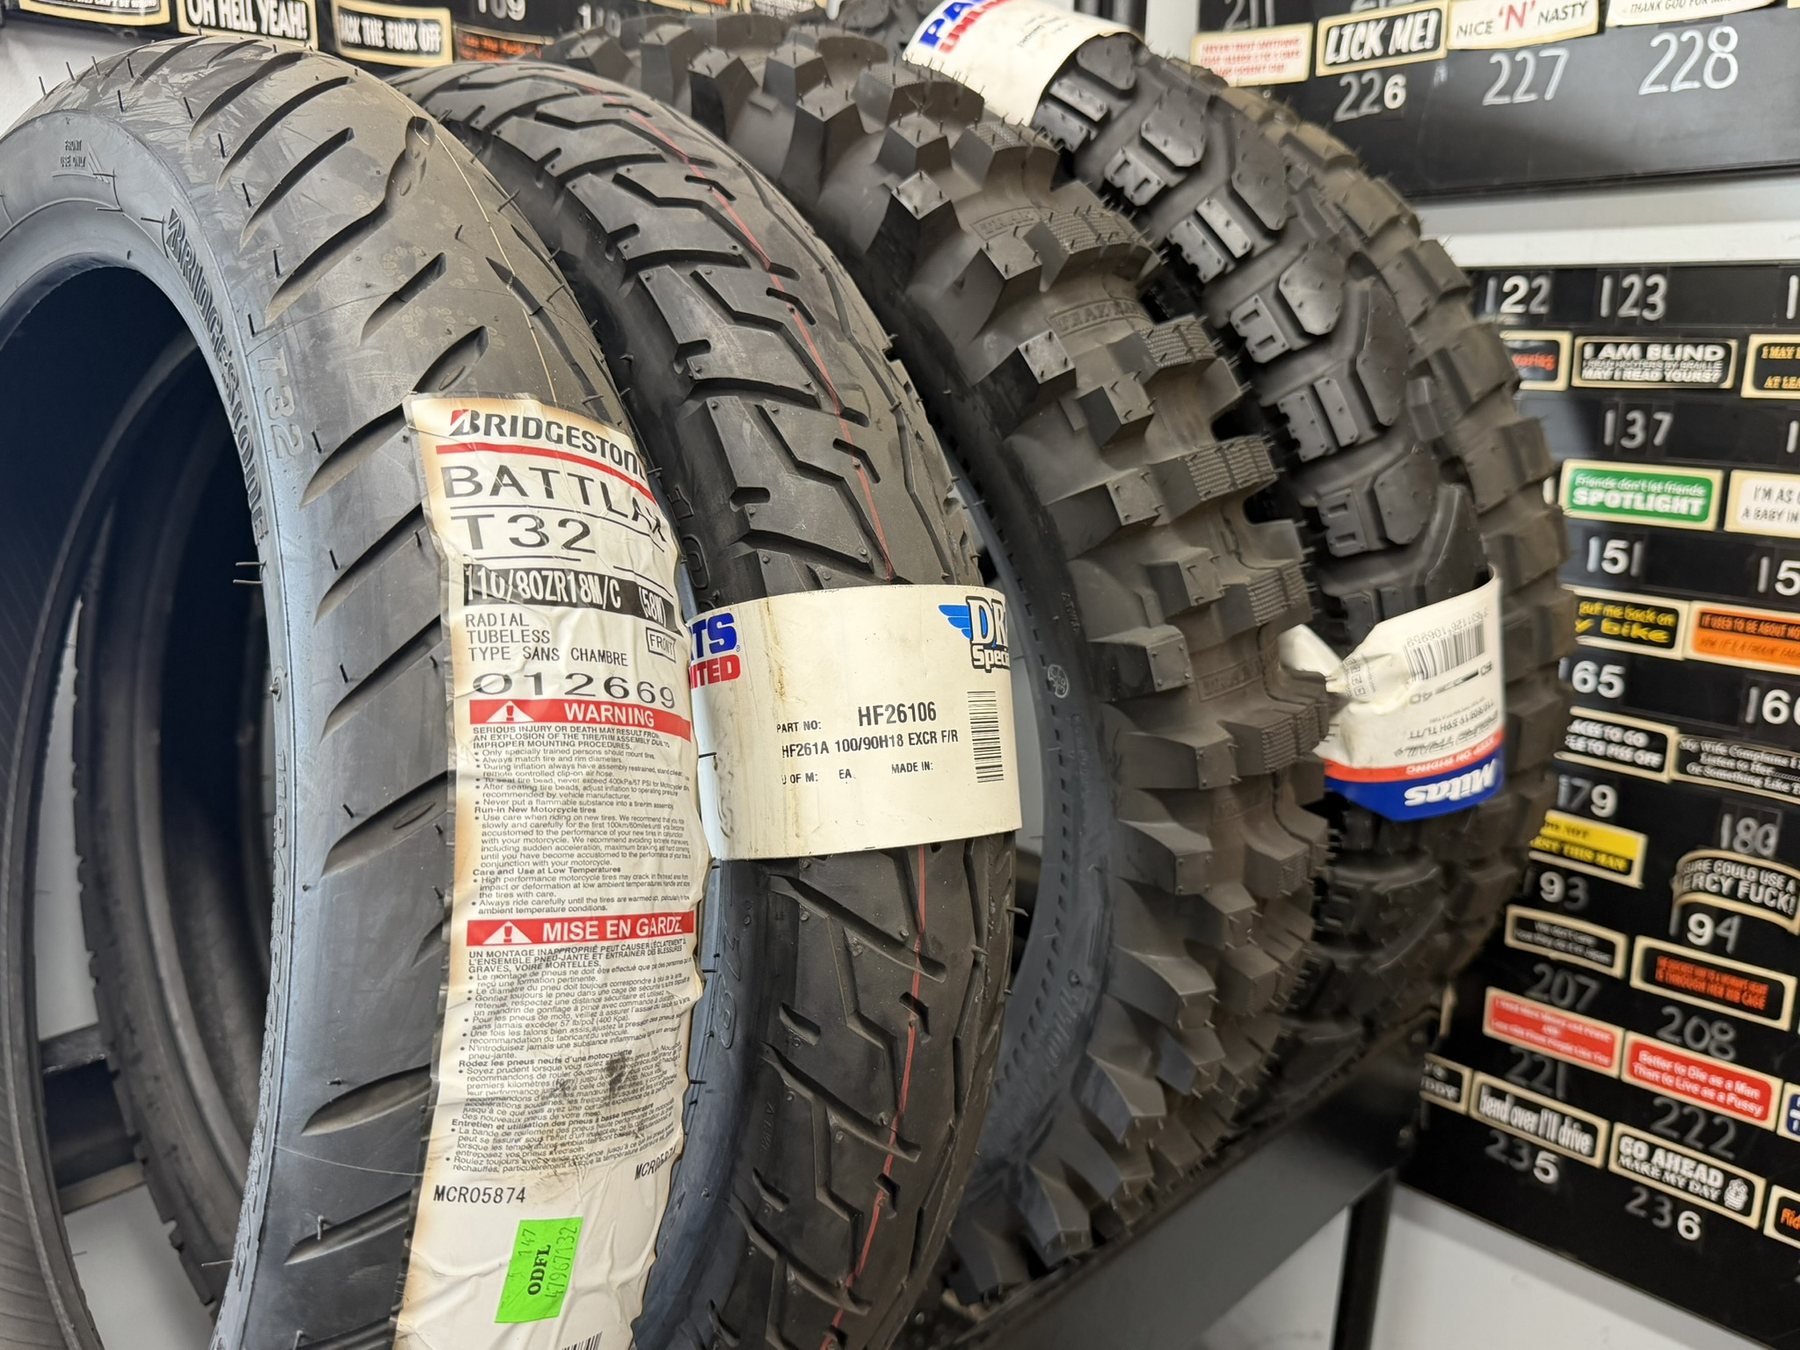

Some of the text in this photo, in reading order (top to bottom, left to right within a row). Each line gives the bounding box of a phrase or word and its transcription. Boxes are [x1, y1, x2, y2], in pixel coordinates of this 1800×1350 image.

[189, 0, 308, 39] OH HELL YEAH!
[385, 21, 418, 51] FUCK
[418, 22, 442, 53] OFF
[1324, 19, 1388, 66] LICK
[1388, 10, 1441, 56] ME!
[1456, 21, 1494, 39] NICE
[1537, 1, 1590, 25] NASTY
[1483, 48, 1569, 106] 227
[1638, 26, 1739, 95] 228
[1333, 73, 1407, 122] 226
[1485, 275, 1551, 315] 122
[1600, 274, 1668, 320] 123
[1583, 343, 1726, 362] I AM BLIND
[1623, 371, 1661, 382] READ
[1664, 372, 1723, 384] YOURS?
[1603, 410, 1674, 449] 137
[440, 464, 667, 542] BATTLAX
[1572, 487, 1707, 517] SPOTLIGHT
[450, 513, 596, 554] T32
[1586, 535, 1643, 577] 151
[465, 564, 622, 610] 110/80ZR18M/C
[1757, 556, 1800, 597] 15
[465, 613, 529, 627] RADIAL
[467, 629, 550, 644] TUBELESS
[1601, 618, 1670, 643] bike
[468, 646, 628, 666] TYPE SANS CHAMBRE
[649, 634, 674, 655] FRONT
[472, 672, 675, 709] 012669
[1558, 656, 1626, 699] 165
[563, 703, 655, 727] WARNING
[776, 701, 937, 734] PART NO: HF26106
[1744, 686, 1800, 726] 16
[473, 726, 516, 735] SERIOUS
[519, 725, 552, 733] INJURY
[554, 725, 568, 733] OR
[570, 726, 598, 734] DEATH
[473, 734, 487, 742] AN
[490, 733, 545, 741] EXPLOSION
[582, 733, 616, 742] TIRE/RIM
[473, 740, 633, 750] IMPROPER MOUNTING PROCEDURES.
[782, 729, 959, 759] HF261A 100/90H18 EXCR F/R
[1624, 729, 1649, 748] GO
[1701, 739, 1728, 757] Wife
[789, 773, 801, 785] OF
[805, 772, 818, 783] M:
[891, 762, 919, 774] MADE
[922, 761, 933, 772] IN:
[1633, 748, 1664, 769] OFF
[1404, 759, 1500, 807] Mitas
[1556, 774, 1618, 818] 179
[1704, 765, 1791, 793] Something Like
[475, 806, 506, 814] Run-in
[531, 806, 579, 814] Motorcycle
[1720, 813, 1780, 860] 180
[473, 869, 496, 877] Care
[537, 867, 546, 875] at
[570, 866, 621, 875] Temperatures
[1712, 860, 1797, 895] COULD USE A
[1735, 881, 1797, 916] FUCK!
[542, 921, 599, 942] MISE
[606, 919, 633, 939] EN
[469, 951, 484, 959] UN
[486, 950, 535, 958] MONTAGE
[600, 945, 619, 953] PEUT
[620, 942, 650, 951] CAUSER
[469, 956, 533, 966] L'ENSEMBLE
[534, 952, 591, 963] PNEU-JANTE
[515, 963, 543, 971] VOIRE
[545, 960, 601, 970] MORTELLES.
[1524, 962, 1601, 1010] 207
[1656, 1005, 1736, 1062] 208
[459, 1060, 489, 1068] Rodez
[507, 1058, 535, 1067] pneus
[1505, 1045, 1568, 1100] 221
[1638, 1050, 1761, 1100] Better to Die as Man
[1662, 1071, 1763, 1118] to Live as Pussy
[452, 1118, 497, 1129] Entretien
[1512, 1105, 1594, 1156] over I'll drive
[1651, 1097, 1737, 1161] 222
[1484, 1128, 1561, 1185] 235
[1619, 1136, 1724, 1190] GO AHEAD
[433, 1185, 527, 1204] MCR05874
[1618, 1155, 1723, 1201] MAKE MY DAY
[1625, 1186, 1702, 1241] 236
[527, 1244, 551, 1296] ODFL
